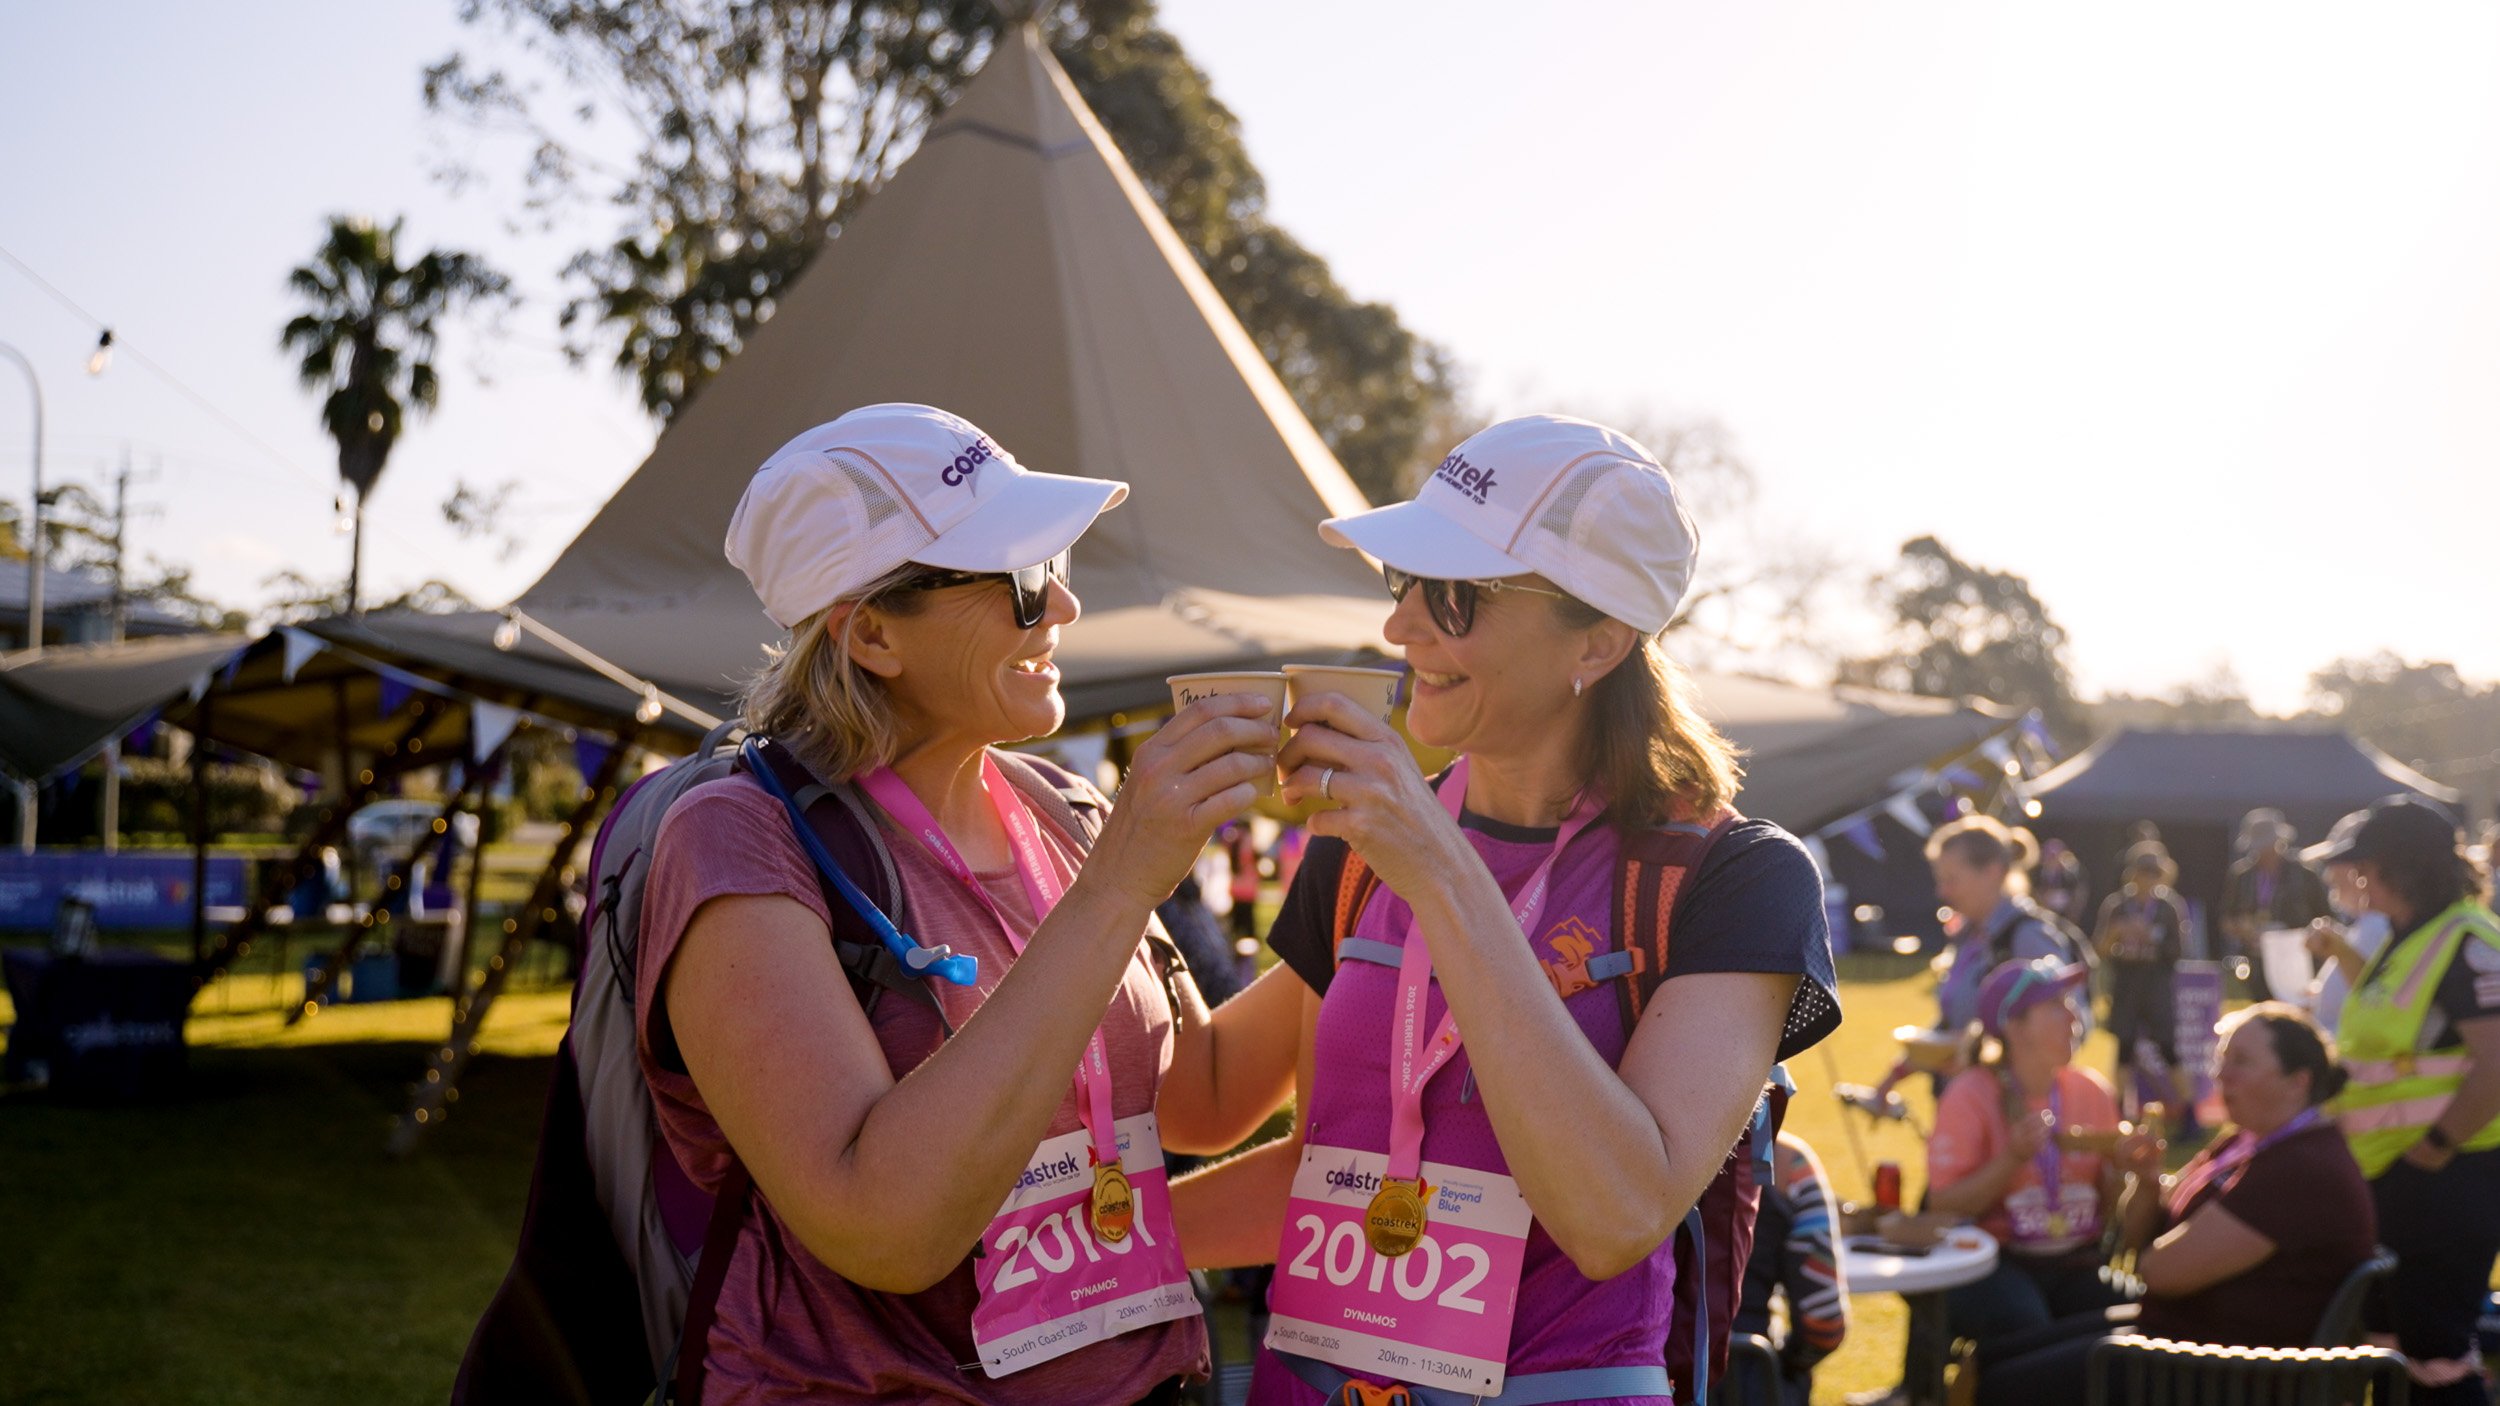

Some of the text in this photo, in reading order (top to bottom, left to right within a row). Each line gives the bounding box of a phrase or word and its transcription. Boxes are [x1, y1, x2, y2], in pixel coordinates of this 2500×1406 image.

[1437, 453, 1497, 498] strek
[1404, 1011, 1415, 1059] TERRIFIC
[1326, 1170, 1383, 1191] coastr
[1441, 1186, 1482, 1203] Beyond
[1438, 1199, 1461, 1213] Blue
[1371, 1216, 1417, 1229] coastrek
[1071, 1278, 1118, 1301] DYNAMOS
[1116, 1303, 1147, 1319] 20km
[1343, 1308, 1397, 1328] DYNAMOS
[1002, 1321, 1088, 1359] South Coast 2026
[1280, 1326, 1340, 1349] South Coast 2026
[1378, 1349, 1409, 1366] 20km
[1421, 1359, 1472, 1380] 11:30AM
